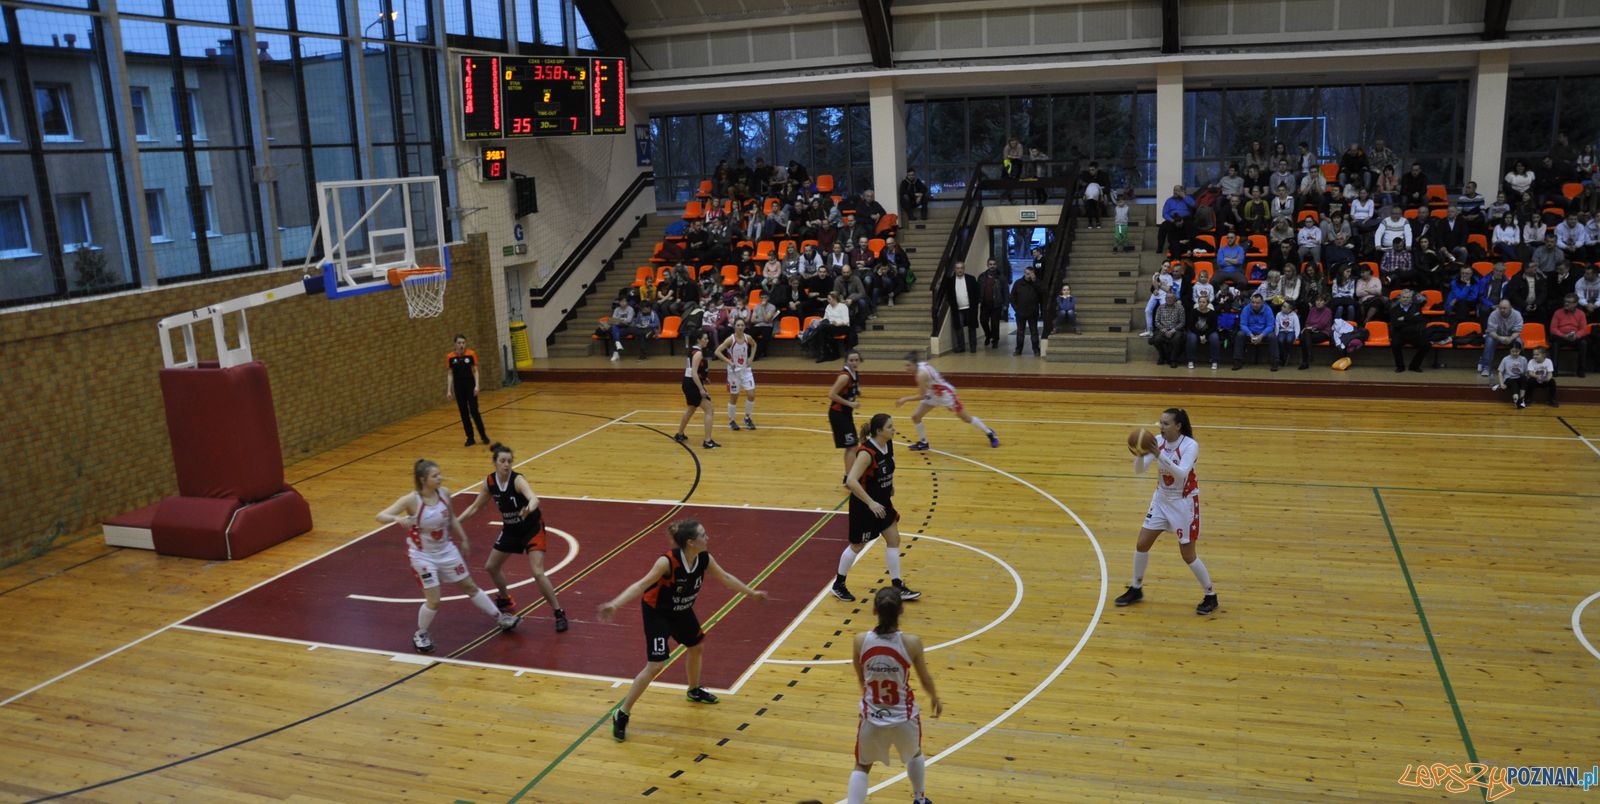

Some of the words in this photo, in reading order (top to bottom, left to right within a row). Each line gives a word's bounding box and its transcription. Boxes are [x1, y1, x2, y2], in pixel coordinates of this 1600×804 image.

[505, 70, 513, 81] 0
[579, 70, 587, 81] 3
[543, 92, 551, 103] 2
[512, 117, 533, 134] 35
[569, 116, 579, 132] 7
[514, 223, 524, 241] G
[510, 496, 518, 509] 7
[1176, 528, 1183, 540] 6
[653, 637, 666, 652] 13
[867, 680, 900, 706] 13
